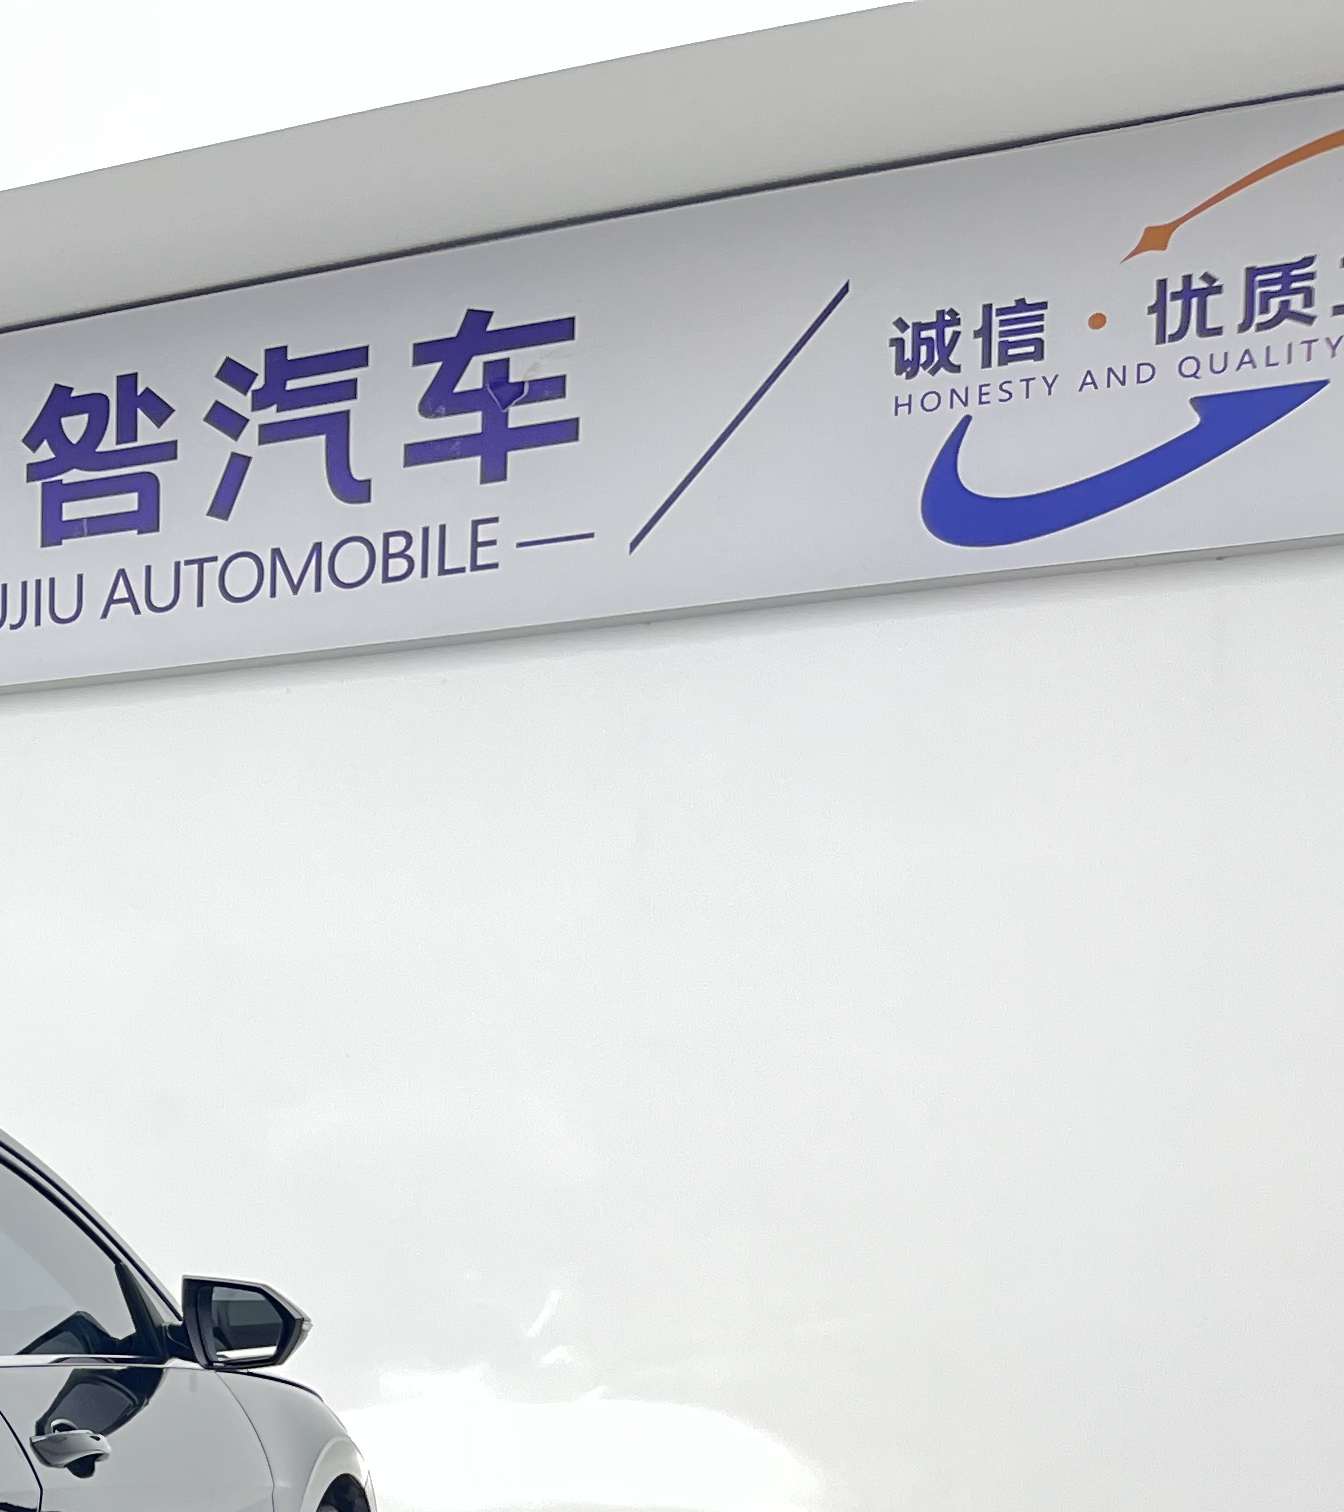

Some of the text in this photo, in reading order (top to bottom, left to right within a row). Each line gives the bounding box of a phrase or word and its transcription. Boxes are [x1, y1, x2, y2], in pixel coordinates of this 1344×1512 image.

[894, 335, 1344, 416] HONESTY AND QUALITY
[99, 517, 500, 620] AUTOMOBILE
